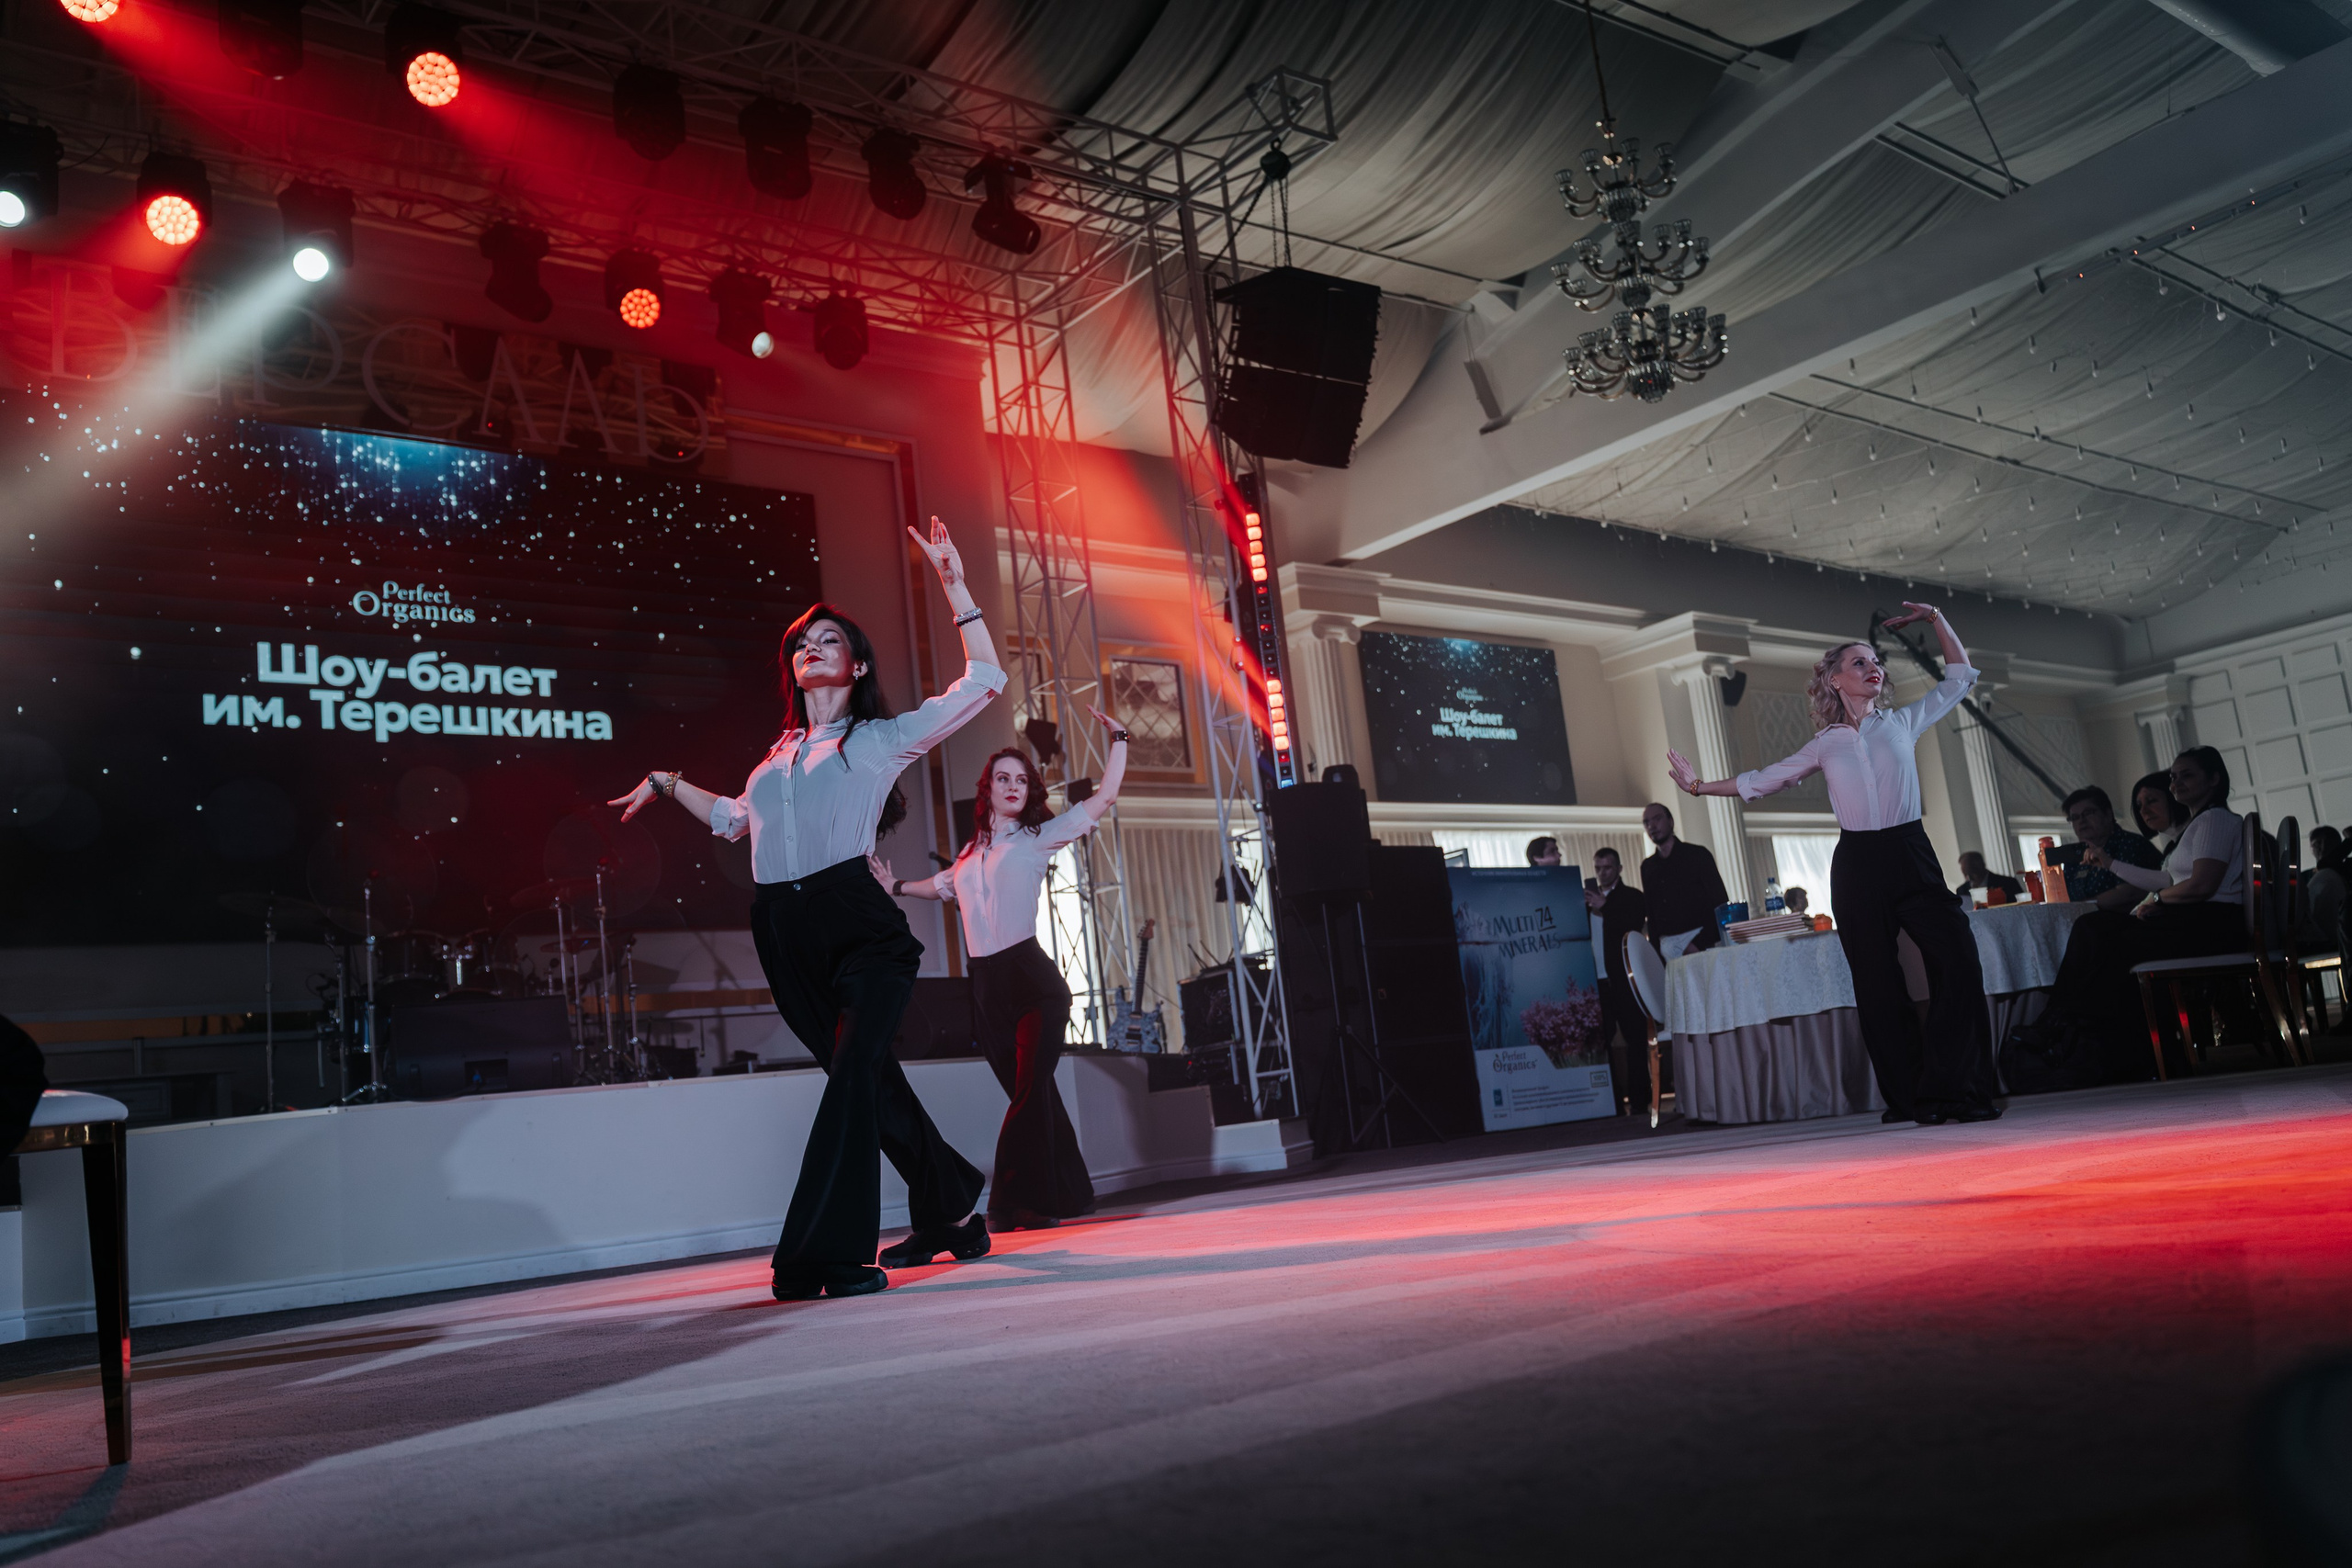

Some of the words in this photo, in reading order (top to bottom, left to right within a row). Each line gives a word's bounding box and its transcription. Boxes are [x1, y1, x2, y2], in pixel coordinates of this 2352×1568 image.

[382, 580, 451, 604] Perfect
[352, 590, 476, 624] Organics
[256, 641, 558, 698] Шоу-балет
[202, 693, 302, 728] им.
[309, 688, 614, 743] Терешкина
[1439, 707, 1503, 727] Шоу-балет
[1431, 724, 1453, 737] им.
[1452, 722, 1518, 740] Терешкина
[1493, 915, 1534, 937] MULTI
[1535, 905, 1555, 930] 74
[1498, 933, 1561, 959] MINERALS
[1493, 1058, 1536, 1074] Organics
[1501, 1050, 1527, 1062] Perfect
